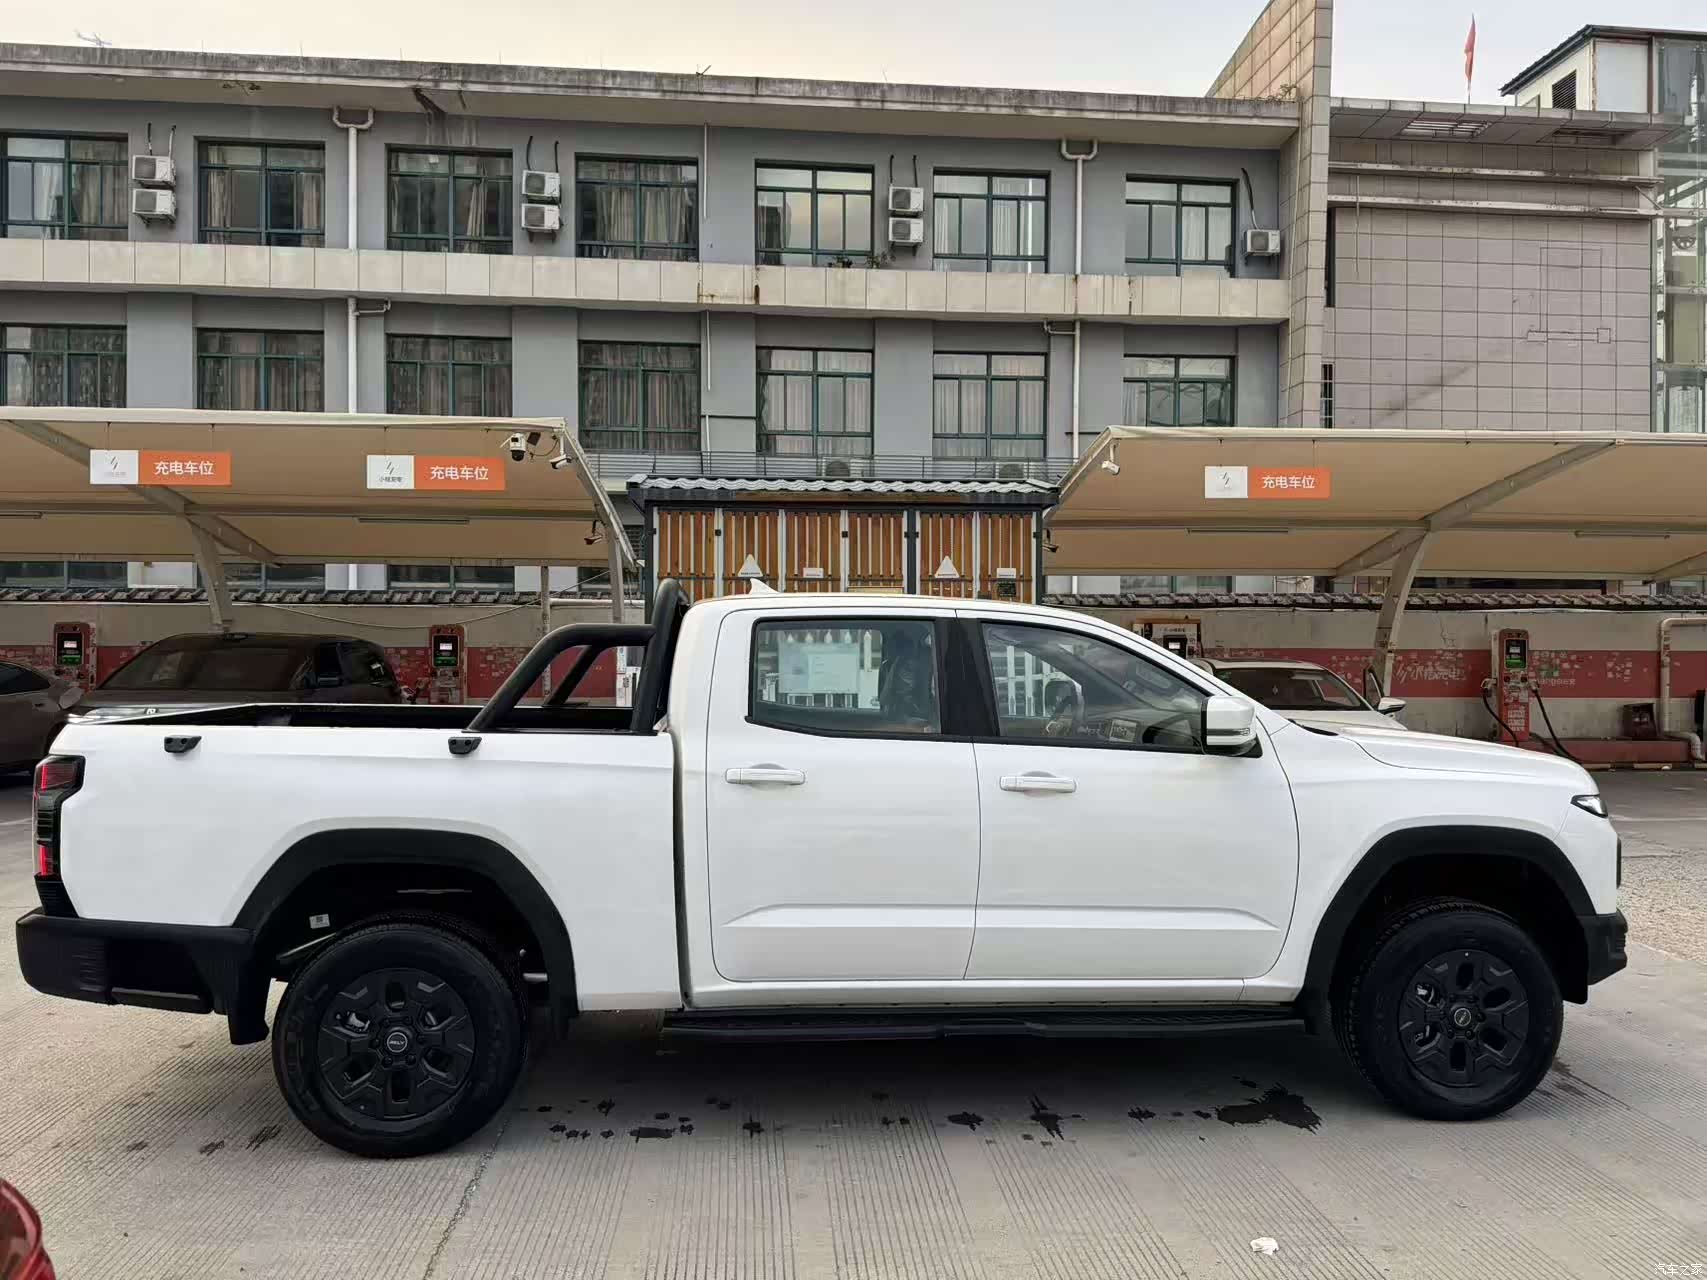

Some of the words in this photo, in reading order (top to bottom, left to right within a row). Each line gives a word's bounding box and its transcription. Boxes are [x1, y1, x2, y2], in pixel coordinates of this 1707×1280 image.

[154, 460, 215, 476] 充电车位
[430, 465, 489, 481] 充电车位
[1262, 475, 1315, 489] 充电车位
